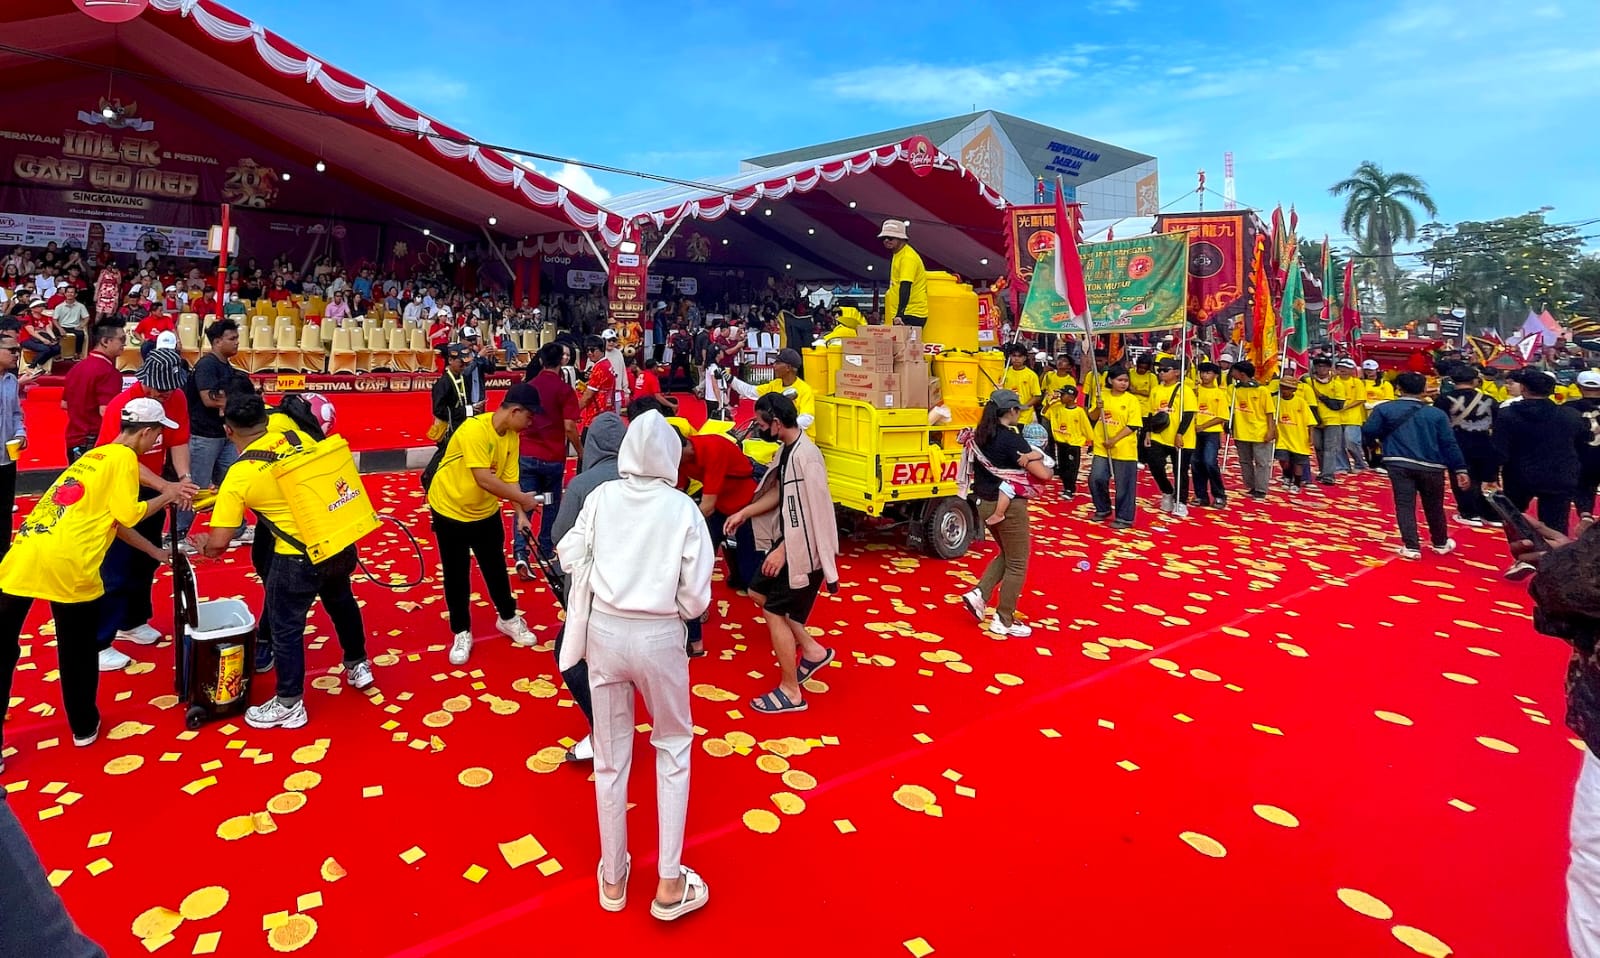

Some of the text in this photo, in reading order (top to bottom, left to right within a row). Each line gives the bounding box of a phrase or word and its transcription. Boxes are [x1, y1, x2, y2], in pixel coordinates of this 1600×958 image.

[62, 129, 161, 167] IMLEK
[174, 153, 219, 165] FESTIVAL
[14, 154, 199, 198] CAP GO MEH
[72, 192, 144, 206] SINGKAWANG
[545, 255, 572, 266] Group
[305, 382, 352, 391] FESTIVAL
[389, 377, 411, 392] GO
